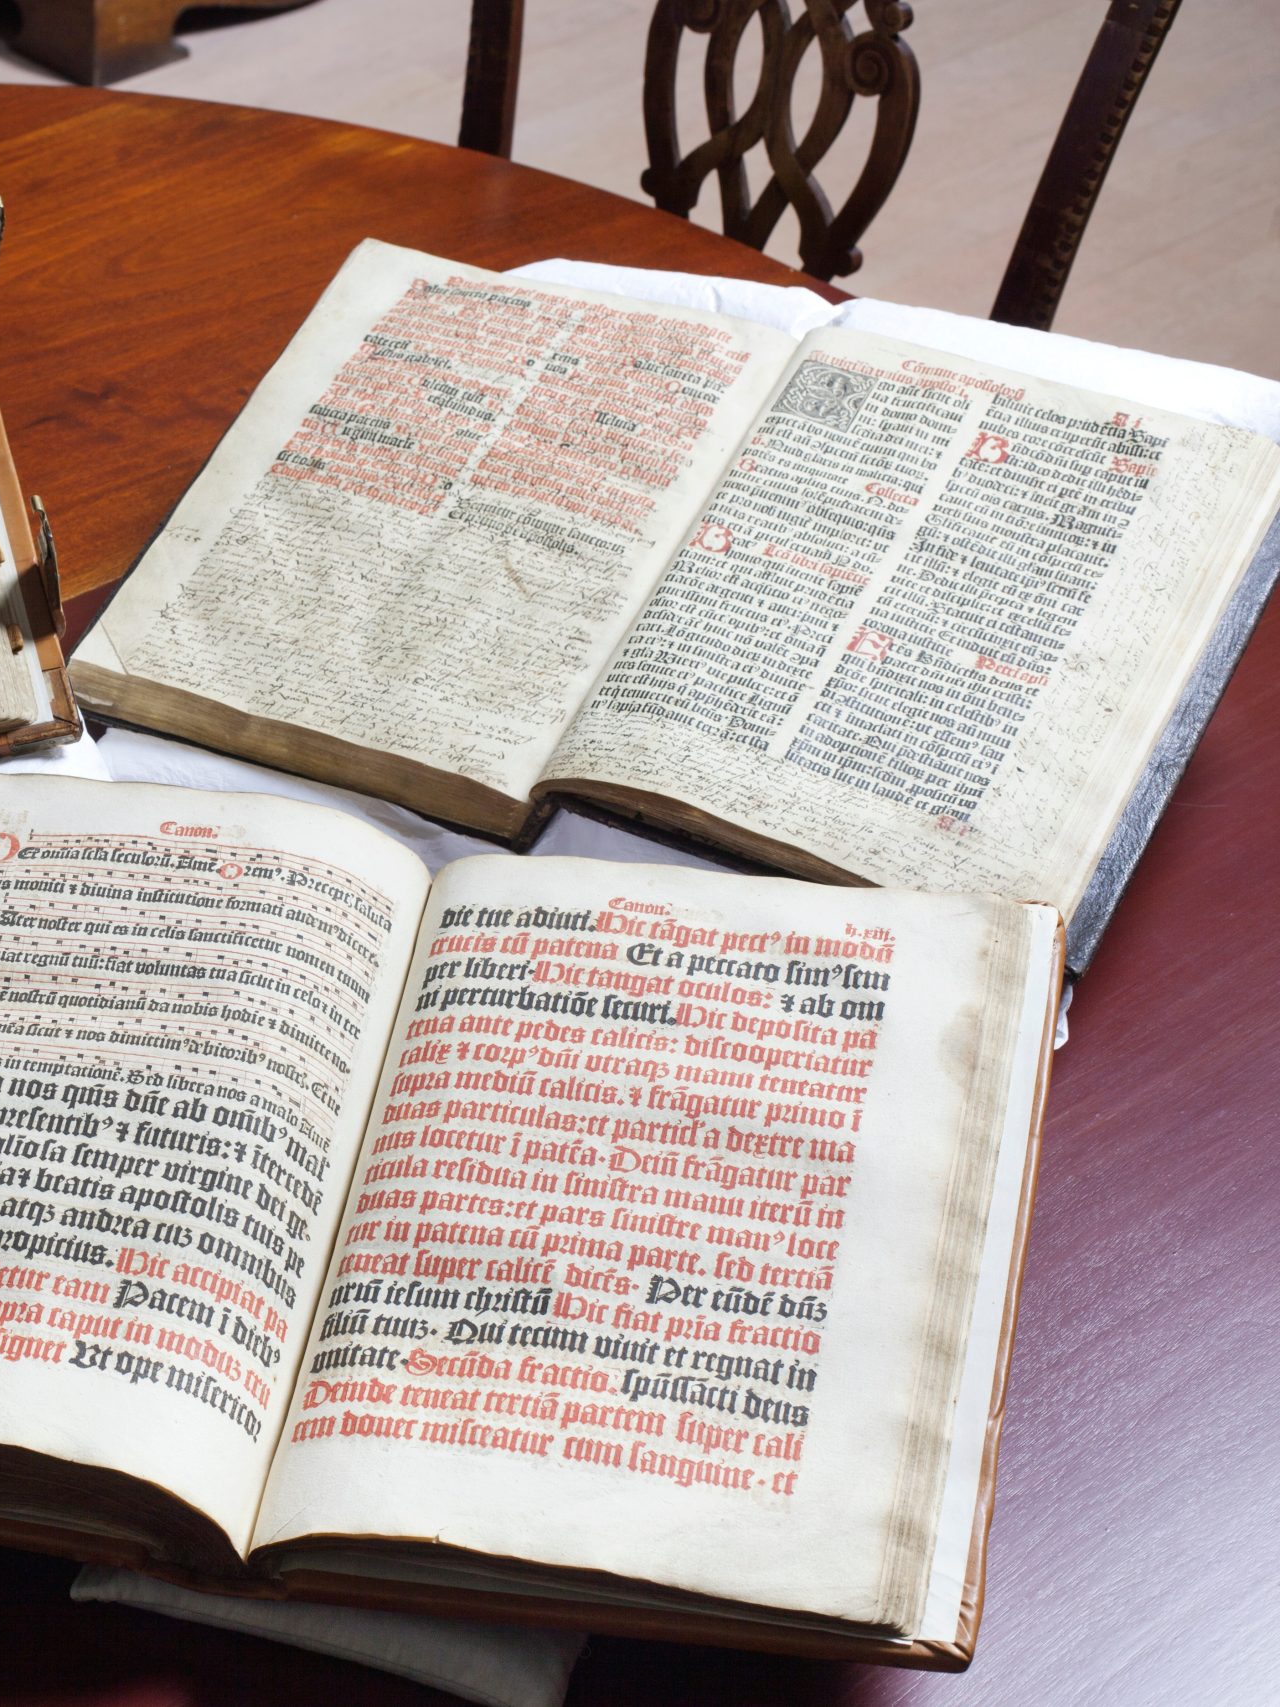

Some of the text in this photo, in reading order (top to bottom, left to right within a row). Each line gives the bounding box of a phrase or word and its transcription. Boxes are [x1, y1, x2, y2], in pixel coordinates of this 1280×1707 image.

[131, 923, 147, 937] in
[285, 944, 335, 976] nomen
[530, 936, 620, 960] patena
[666, 951, 685, 969] a
[784, 931, 811, 955] in
[421, 958, 461, 990] per
[799, 992, 835, 1018] ab
[457, 1015, 587, 1044] ante pedes
[7, 1077, 208, 1123] nos ab
[539, 1202, 606, 1225] pars
[241, 1214, 285, 1256] tuis
[384, 1215, 411, 1242] in
[413, 1220, 506, 1249] patena
[47, 1305, 154, 1344] caput in
[613, 1301, 663, 1334] fiat
[663, 1347, 688, 1369] et
[786, 1359, 817, 1392] in
[771, 1469, 798, 1496] et
